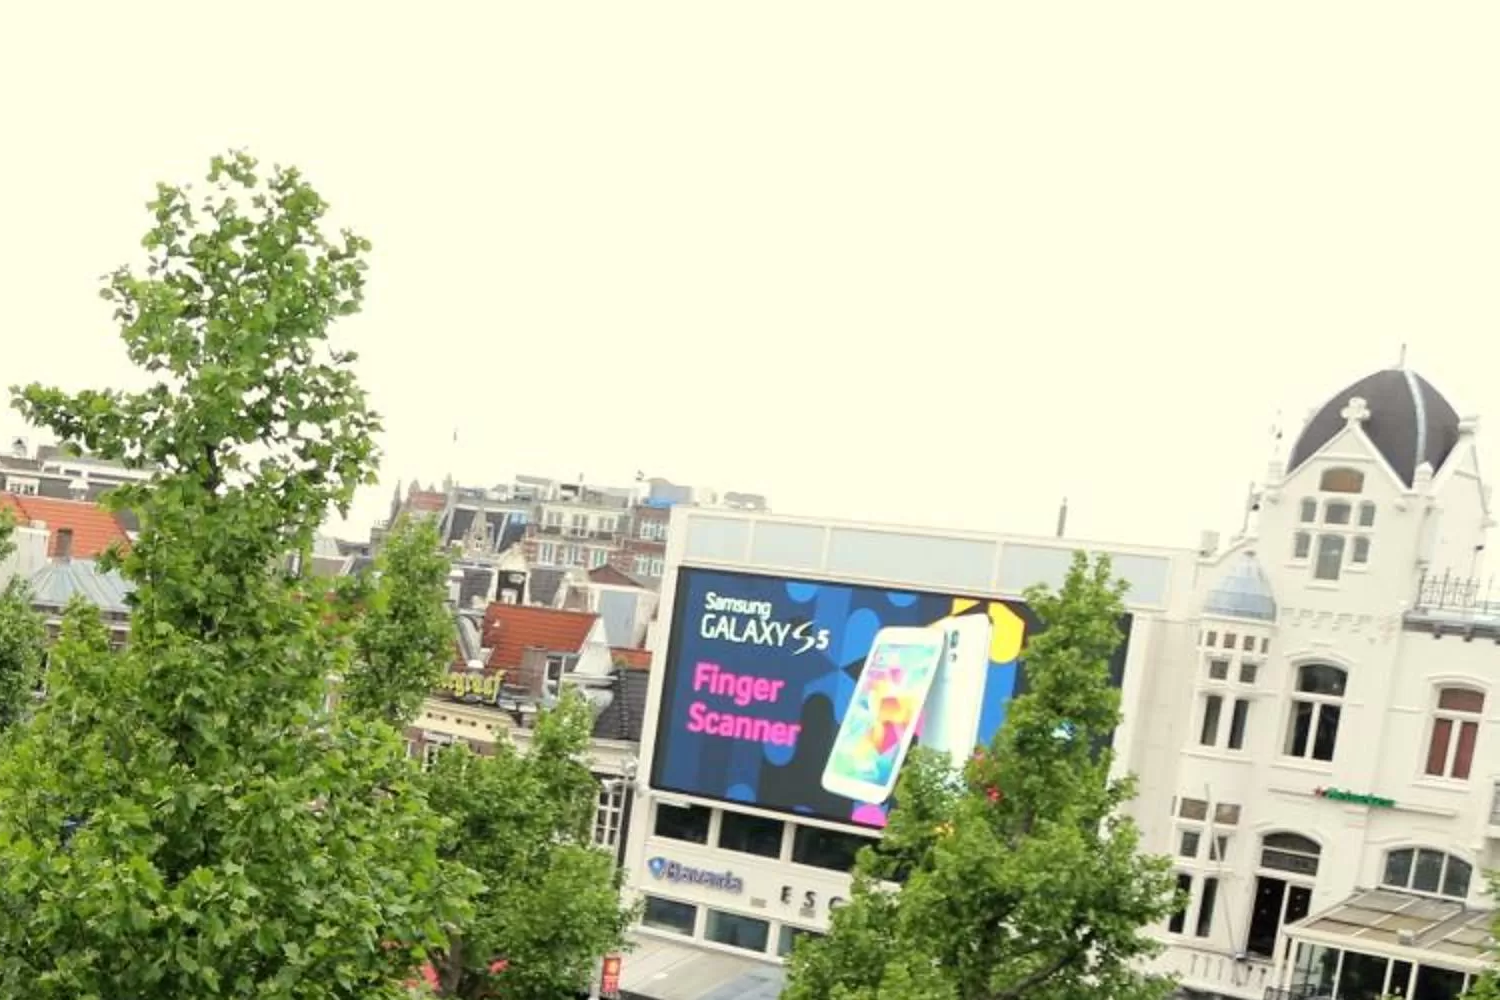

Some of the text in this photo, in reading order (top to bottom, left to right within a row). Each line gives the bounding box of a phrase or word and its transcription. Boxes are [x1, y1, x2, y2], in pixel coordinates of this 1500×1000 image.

[705, 591, 772, 620] Samsung
[701, 614, 791, 647] GALAXY
[693, 661, 785, 706] Finger
[686, 702, 802, 747] Scanner
[780, 885, 846, 920] ESC
